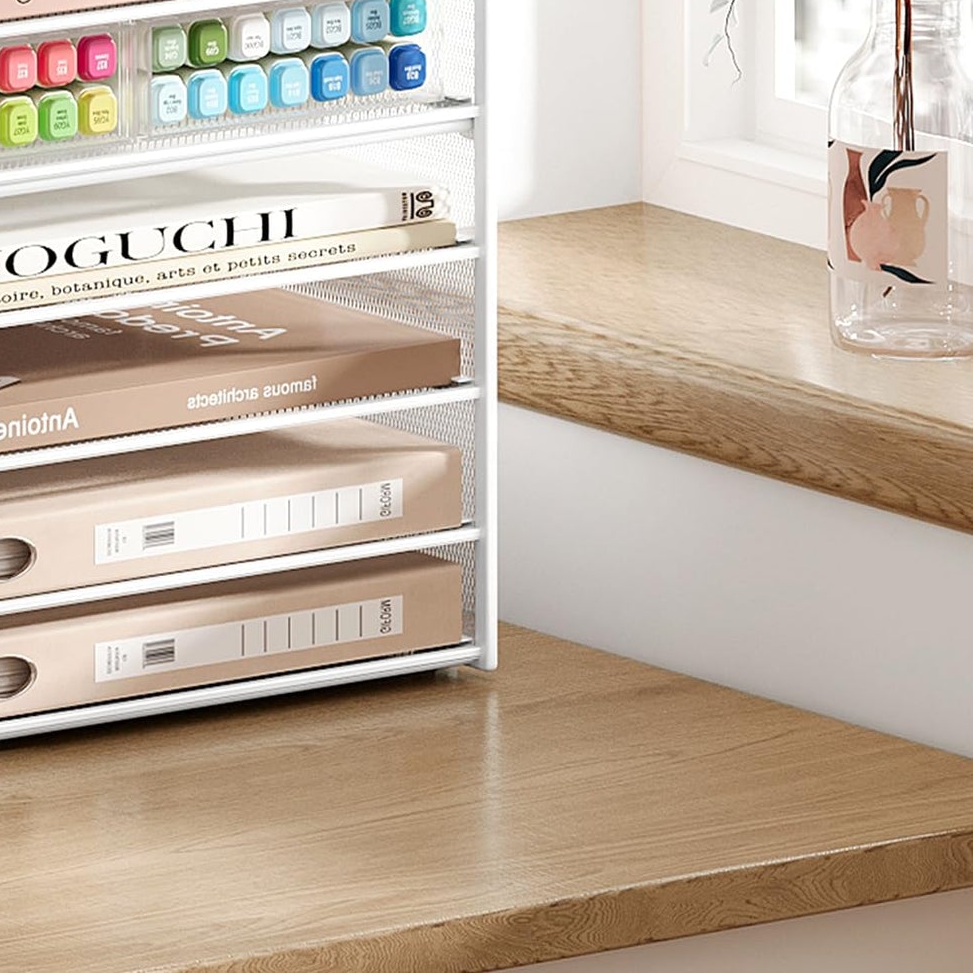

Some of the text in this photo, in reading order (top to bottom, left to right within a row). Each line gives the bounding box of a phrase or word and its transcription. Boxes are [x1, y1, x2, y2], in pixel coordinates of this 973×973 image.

[52, 269, 150, 297] botanique,
[156, 265, 196, 282] arts
[203, 260, 221, 274] et
[227, 252, 281, 273] petits
[288, 242, 357, 262] secrets
